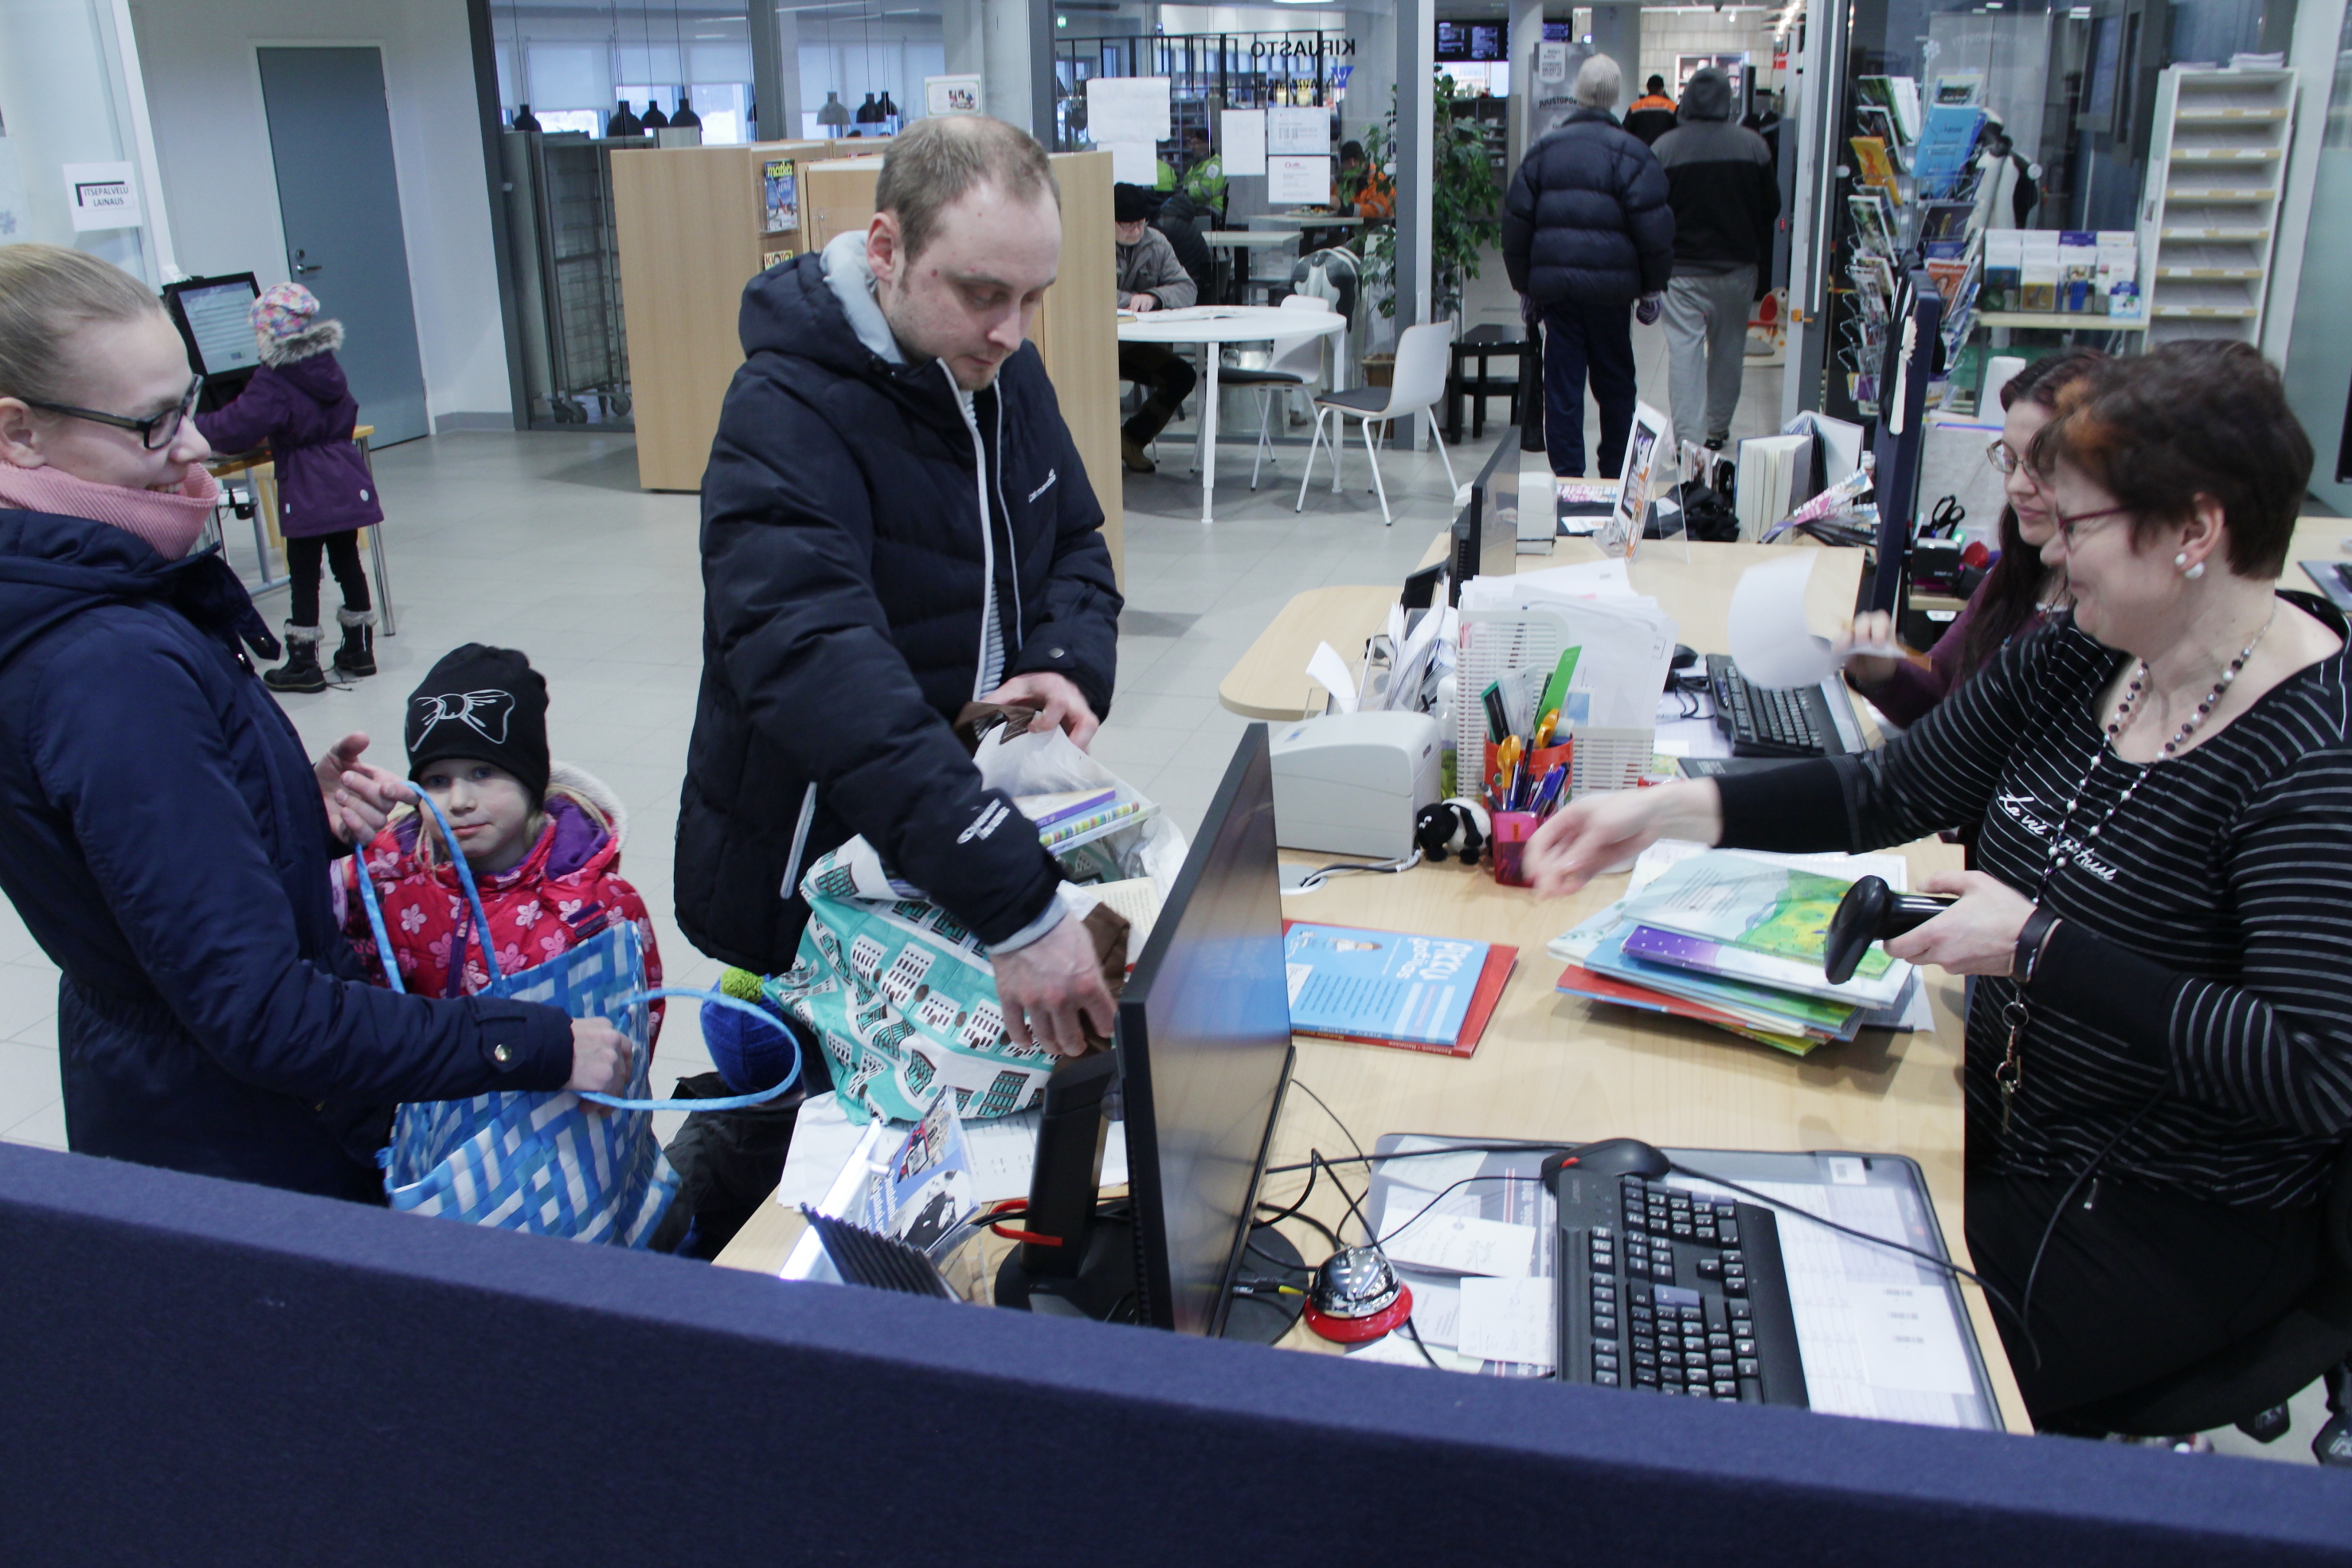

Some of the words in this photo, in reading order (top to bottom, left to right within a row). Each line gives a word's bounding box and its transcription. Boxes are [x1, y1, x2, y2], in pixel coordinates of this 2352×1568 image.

[767, 161, 793, 178] matka
[84, 186, 129, 197] ITSEPALVELU
[93, 197, 124, 207] LAINAUS
[1998, 793, 2035, 817] La
[2021, 814, 2048, 835] vie
